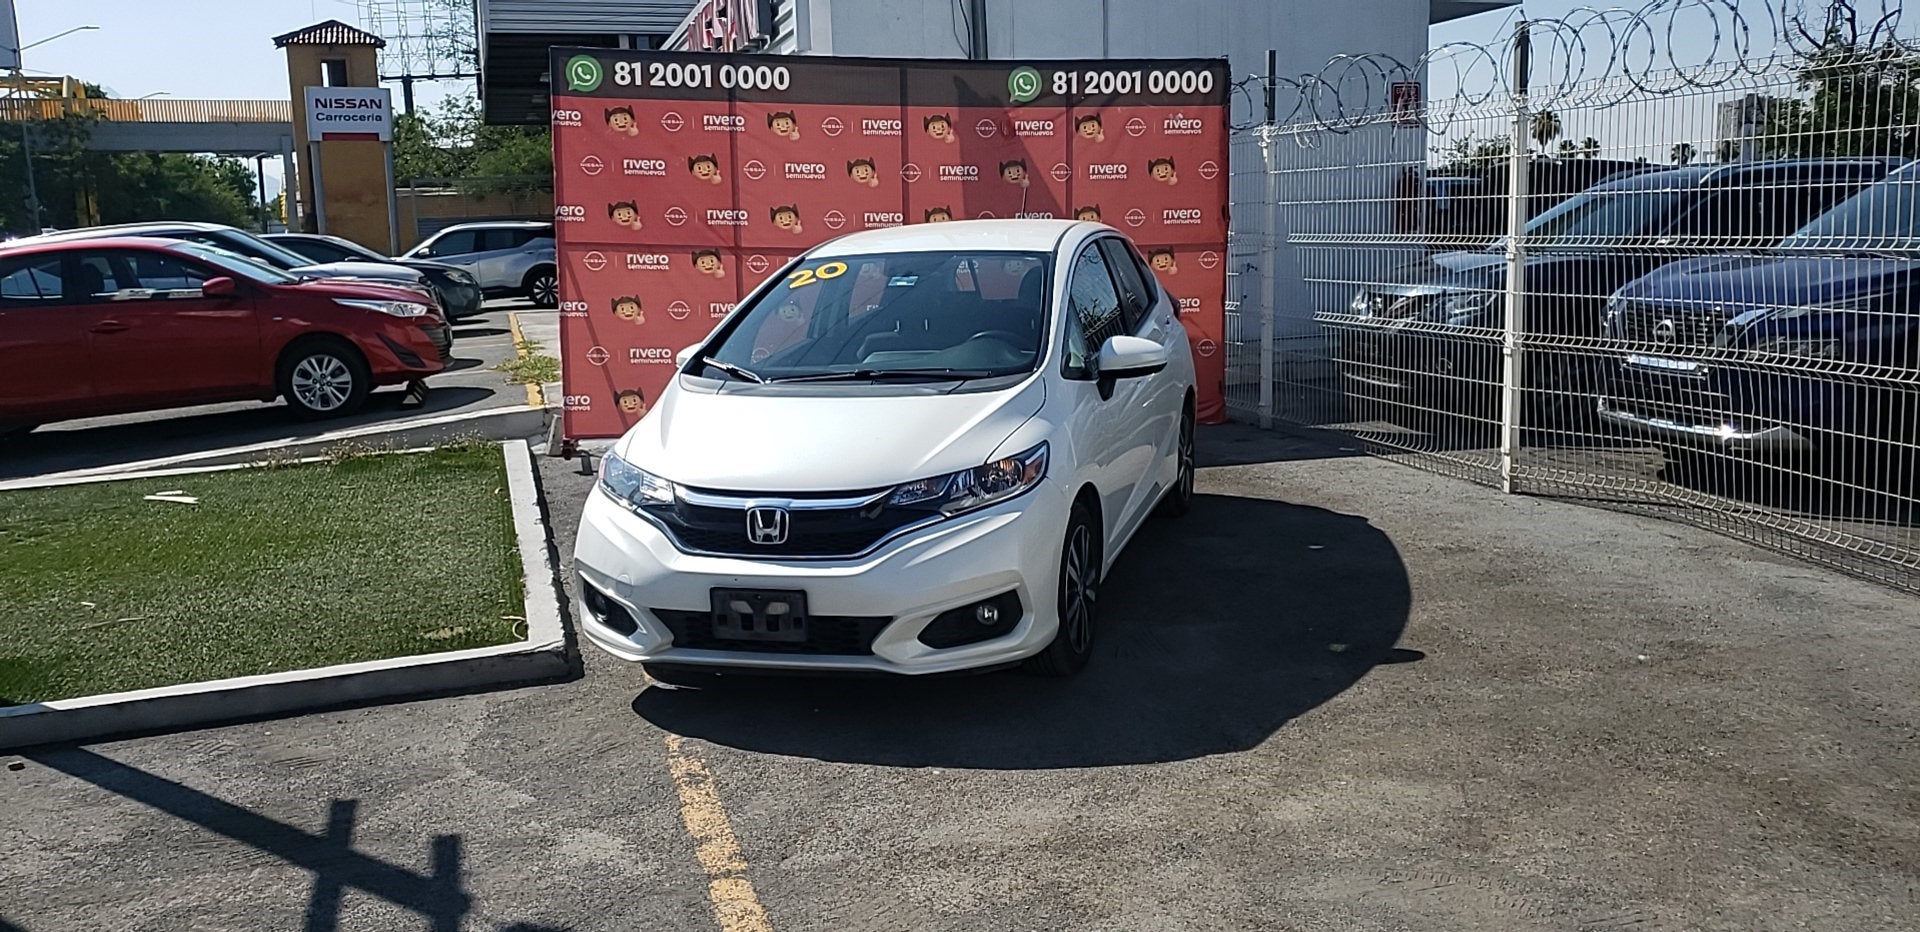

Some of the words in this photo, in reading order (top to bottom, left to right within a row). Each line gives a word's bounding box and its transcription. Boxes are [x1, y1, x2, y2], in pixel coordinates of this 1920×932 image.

[614, 61, 642, 86] 81
[649, 62, 712, 88] 2001
[719, 64, 790, 91] 0000
[1052, 71, 1078, 95] 81
[1084, 70, 1142, 94] 2001
[1148, 70, 1214, 94] 0000
[314, 97, 382, 109] NISSAN
[552, 109, 582, 121] vero
[703, 114, 745, 126] rivero
[862, 119, 902, 130] rivero
[1014, 120, 1054, 131] rivero
[1163, 118, 1202, 129] rivero
[623, 158, 666, 170] rivero
[784, 162, 826, 174] rivero
[939, 164, 979, 175] rivero
[1089, 163, 1128, 174] rivero
[555, 205, 585, 216] vero
[707, 209, 748, 220] rivero
[1163, 208, 1201, 219] rivero
[864, 212, 904, 223] rivero
[626, 253, 670, 265] rivero
[788, 261, 848, 289] 20
[558, 301, 588, 311] vero
[710, 303, 736, 312] rive
[1179, 297, 1200, 307] ero
[629, 347, 672, 358] rivero
[563, 395, 591, 405] ero
